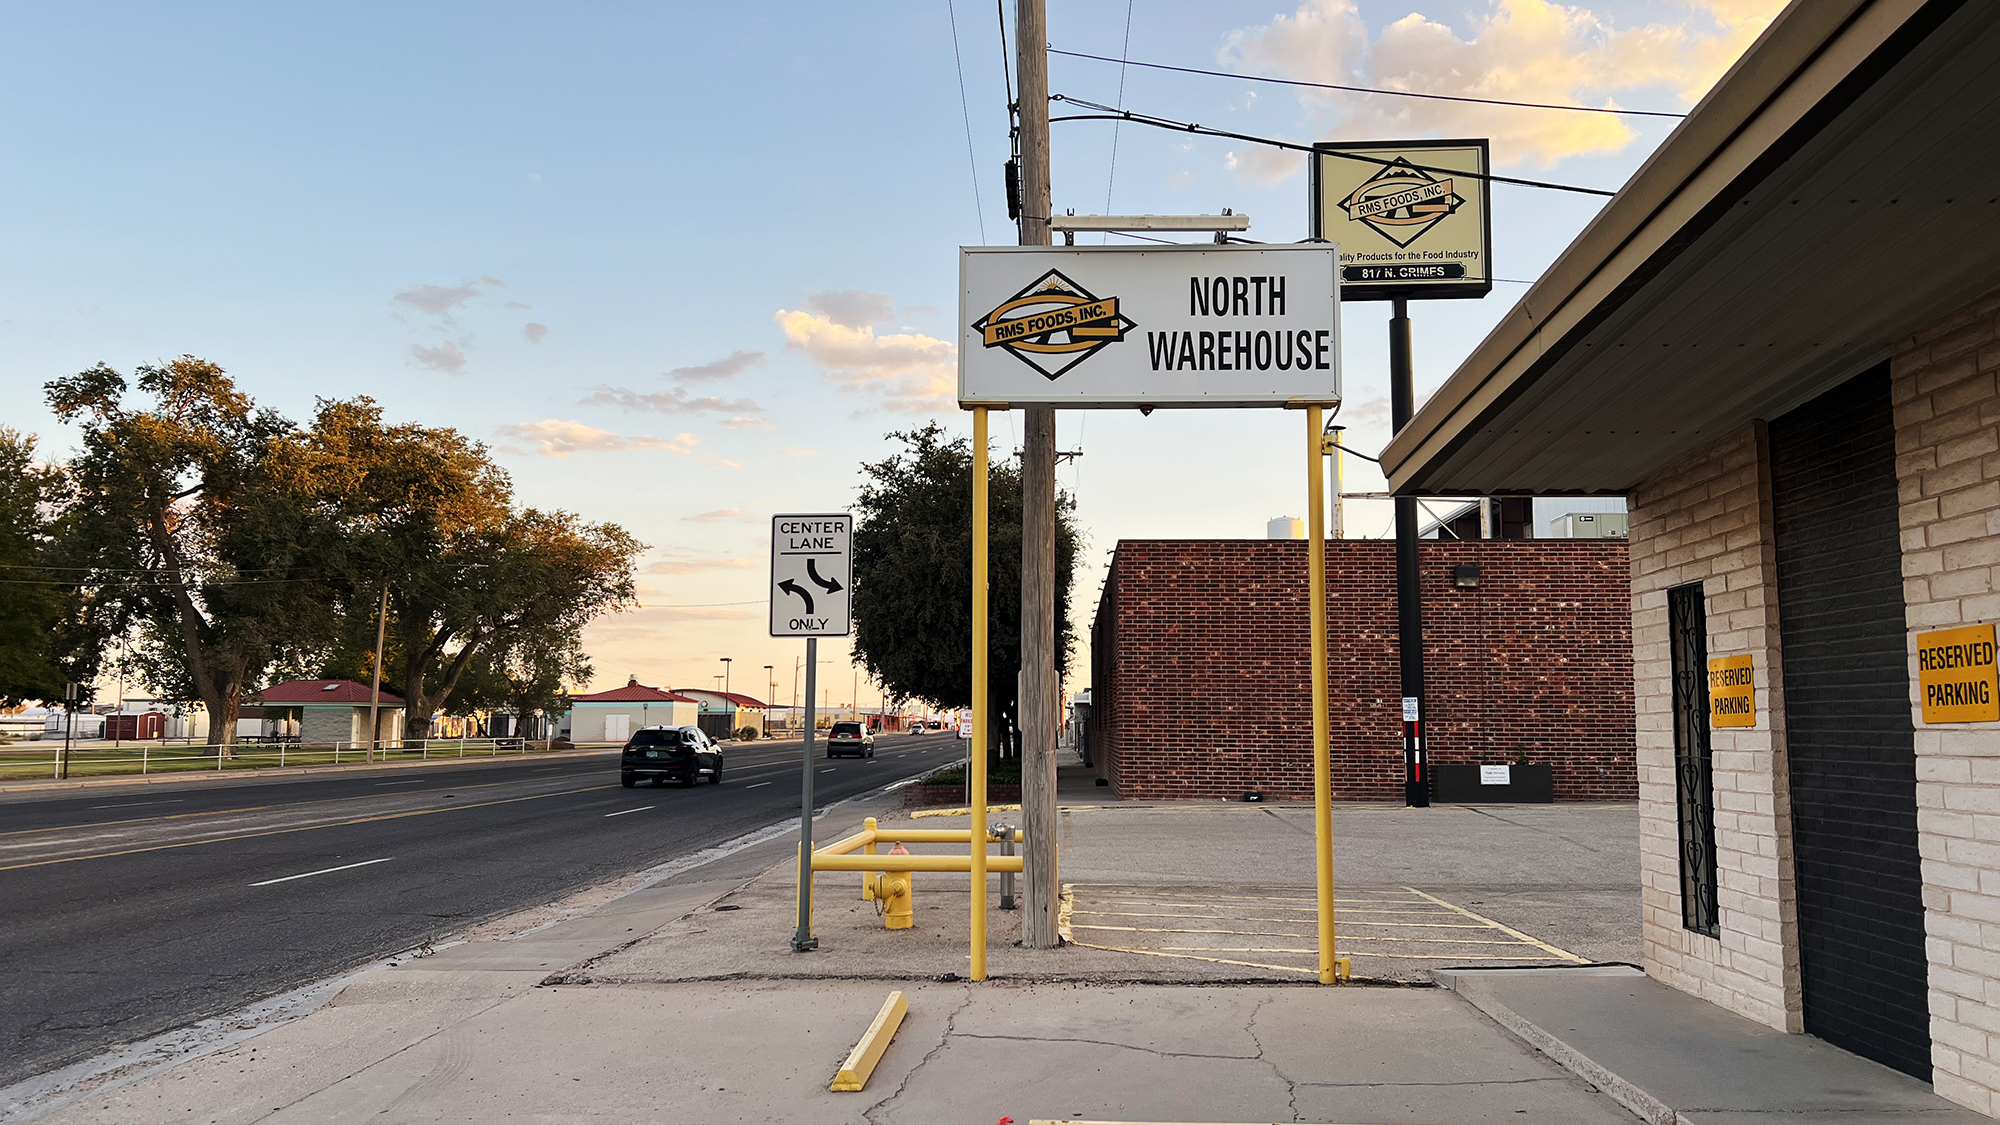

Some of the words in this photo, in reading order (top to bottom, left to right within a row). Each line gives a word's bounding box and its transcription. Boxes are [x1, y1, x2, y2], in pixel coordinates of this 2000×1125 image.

[1359, 201, 1382, 215] RMS
[1383, 190, 1423, 209] FOODS,
[1423, 184, 1446, 198] INC.
[1357, 252, 1393, 260] Products
[1394, 251, 1406, 260] for
[1407, 251, 1421, 260] the
[1422, 250, 1444, 259] Food
[1445, 250, 1479, 259] Industry
[1361, 268, 1381, 279] 817
[1384, 268, 1397, 278] N.
[1399, 266, 1445, 277] GRIMES
[1190, 276, 1286, 317] NORTH
[995, 323, 1025, 340] RMS
[1027, 310, 1078, 333] FOODS,
[1079, 304, 1107, 320] INC.
[1147, 329, 1330, 372] WAREHOUSE
[780, 522, 845, 534] CENTER
[789, 537, 834, 549] LANE
[789, 618, 829, 630] ONLY
[1919, 641, 1993, 671] RESERVED
[1710, 667, 1752, 688] RESERVED
[1927, 680, 1990, 707] PARKING
[1714, 695, 1750, 715] PARKING
